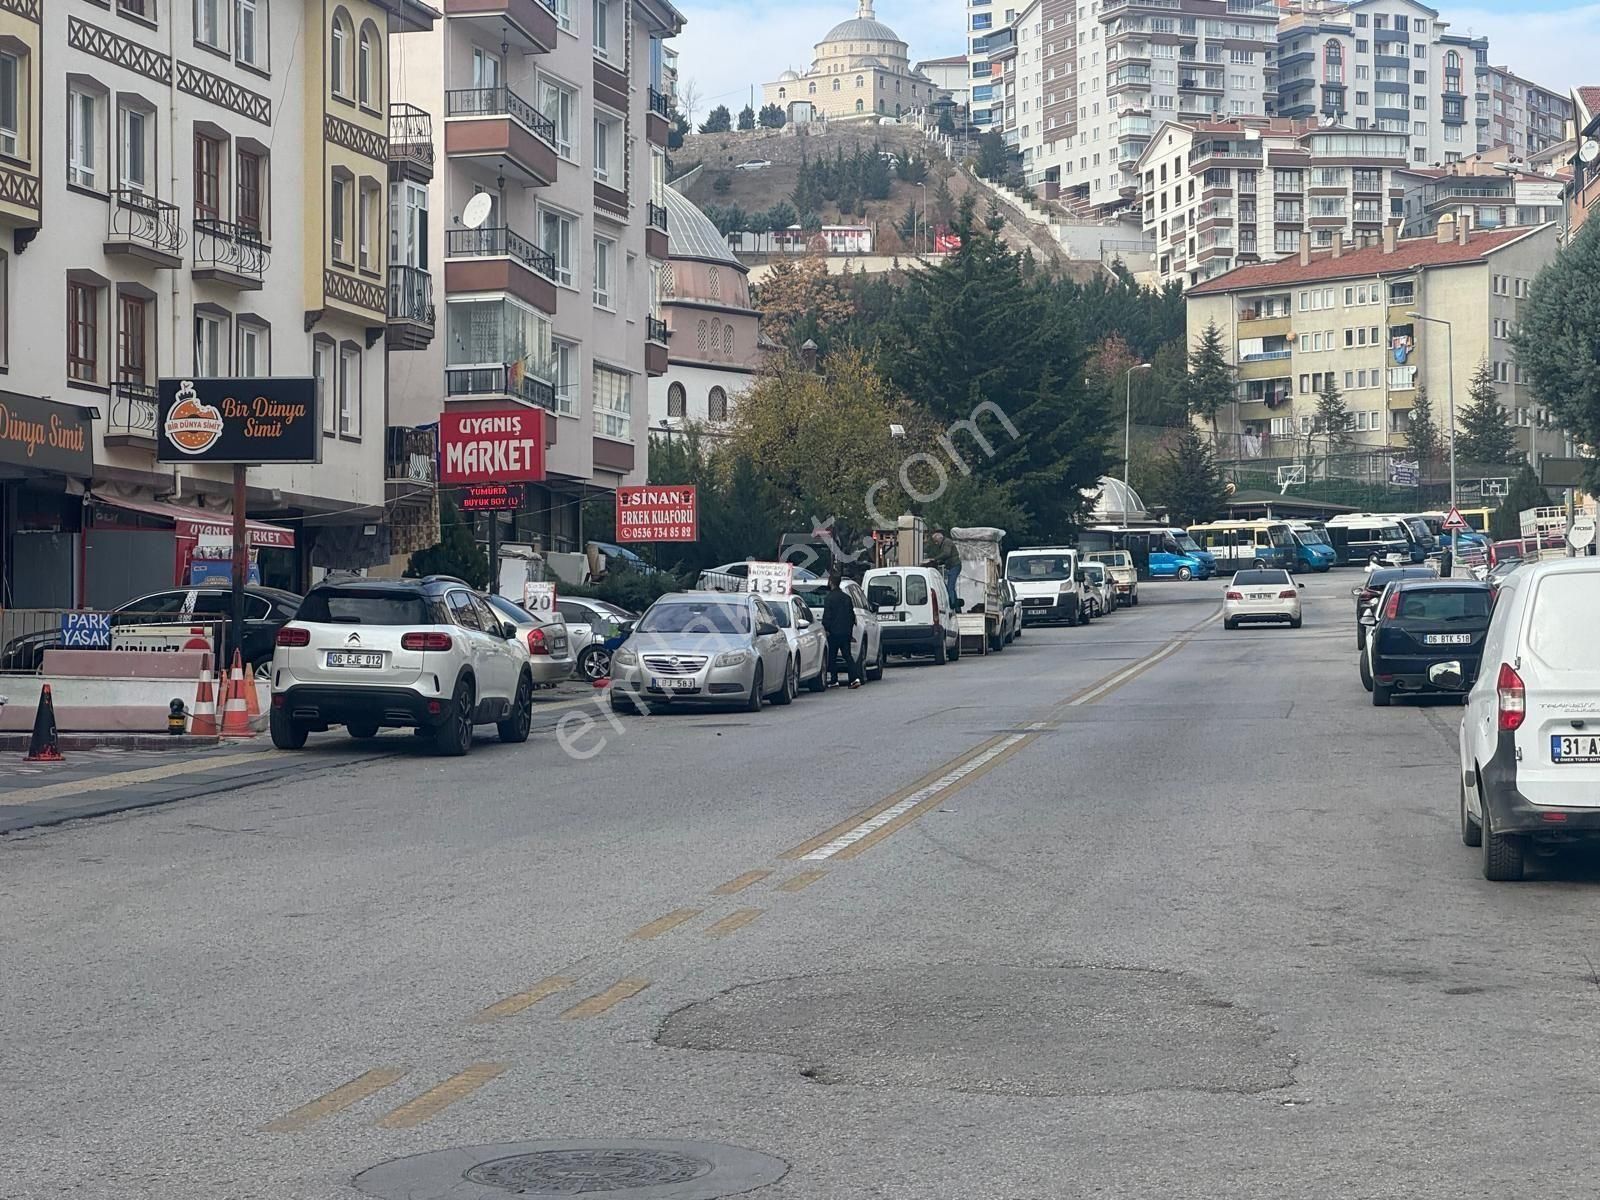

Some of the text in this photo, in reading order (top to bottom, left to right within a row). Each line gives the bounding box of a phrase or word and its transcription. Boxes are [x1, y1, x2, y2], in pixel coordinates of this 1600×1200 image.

[222, 396, 306, 425] Bir Dünya
[49, 414, 84, 452] Simit
[167, 420, 221, 431] BİR DÜNYA SİMİT
[244, 417, 282, 437] Simit
[459, 416, 522, 435] UYANIŞ
[446, 439, 535, 476] MARKET
[470, 487, 507, 496] YUMURTA
[631, 489, 680, 505] SİNAN
[621, 505, 693, 525] ERKEK KUAFÖRÜ
[632, 528, 652, 538] 0536
[670, 526, 679, 537] 85
[681, 526, 691, 537] 82
[751, 577, 787, 594] 135
[528, 595, 550, 610] 20
[68, 613, 110, 630] PARK
[62, 629, 110, 646] YASAK
[1428, 635, 1438, 643] 06
[332, 654, 381, 665] 06 EJE 012
[1563, 737, 1579, 755] 31
